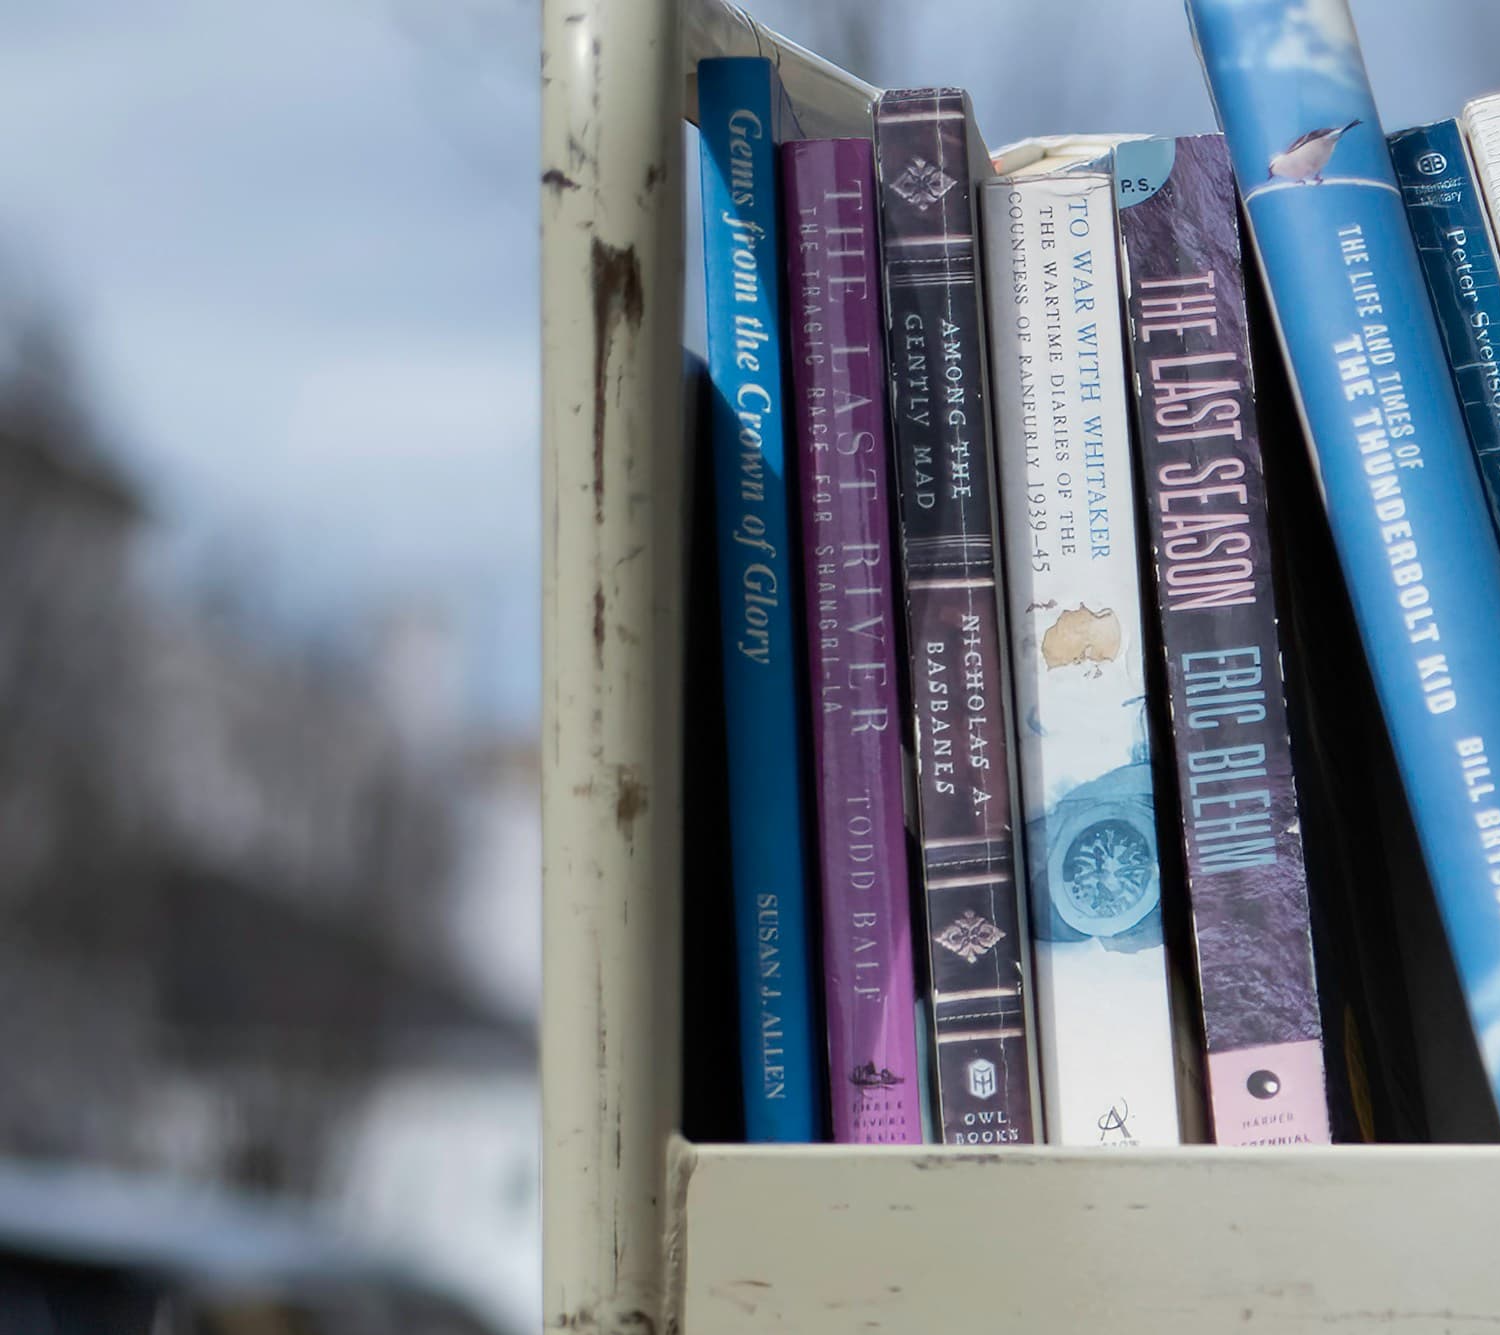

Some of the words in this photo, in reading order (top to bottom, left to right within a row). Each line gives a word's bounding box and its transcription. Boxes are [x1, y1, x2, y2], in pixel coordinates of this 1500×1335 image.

[720, 108, 765, 212] Gems
[1120, 177, 1157, 194] P.S.
[721, 212, 765, 303] from
[1067, 197, 1090, 238] TO
[1072, 249, 1096, 314] WAR
[1140, 269, 1218, 343] THE
[734, 314, 770, 372] the
[1076, 322, 1102, 403] WITH
[1333, 333, 1376, 402] THE
[1150, 351, 1243, 444] LAST
[736, 382, 780, 501] Crown
[1083, 415, 1111, 560] WHITAKER
[1354, 407, 1441, 645] THUNDERBOLT
[733, 513, 778, 560] of
[1157, 457, 1257, 612] SEASON
[737, 562, 779, 665] Glory
[1180, 645, 1267, 730] ERIC
[1416, 653, 1458, 715] KID
[1186, 742, 1278, 874] BLEHM
[1455, 736, 1496, 804] BILL
